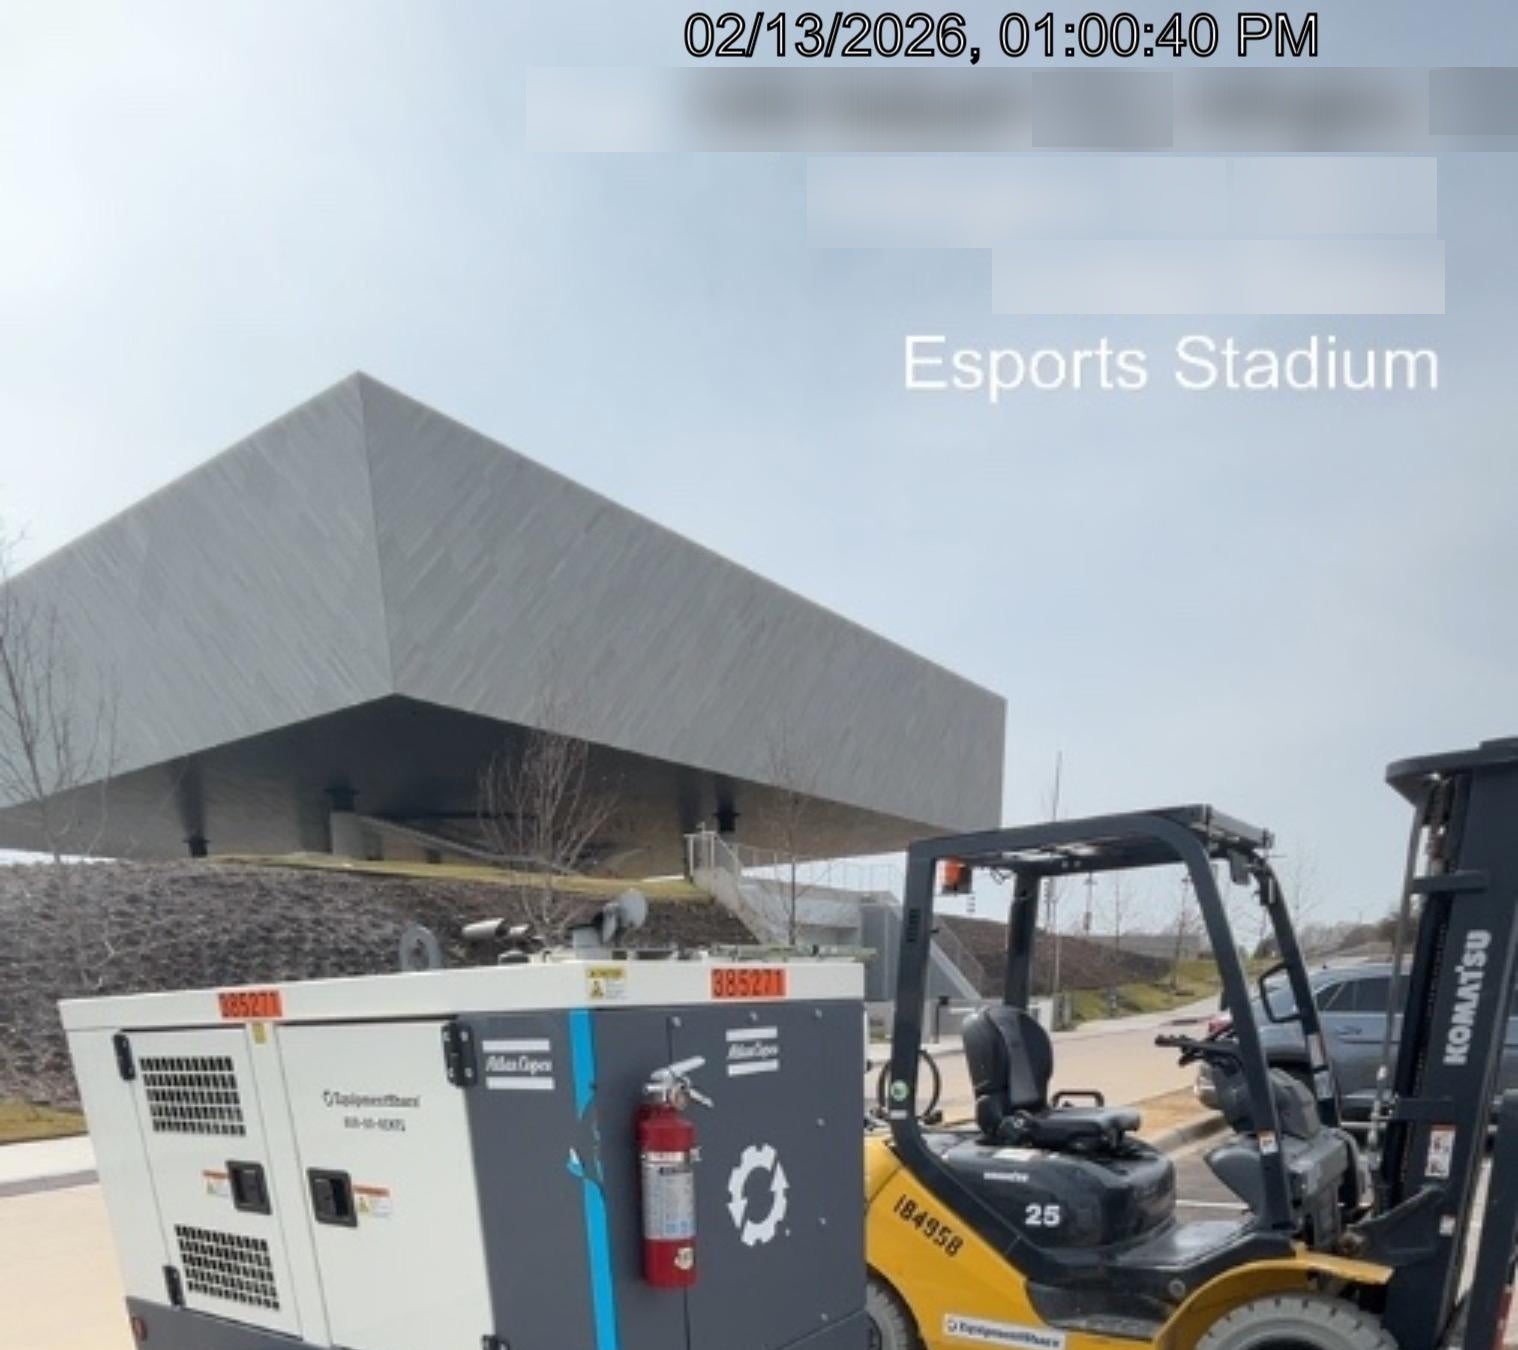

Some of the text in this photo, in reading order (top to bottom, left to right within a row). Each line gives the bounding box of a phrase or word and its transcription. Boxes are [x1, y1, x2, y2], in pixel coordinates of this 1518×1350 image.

[713, 968, 786, 998] 385271
[1443, 929, 1492, 1065] KOMATSU
[1024, 1203, 1060, 1229] 25
